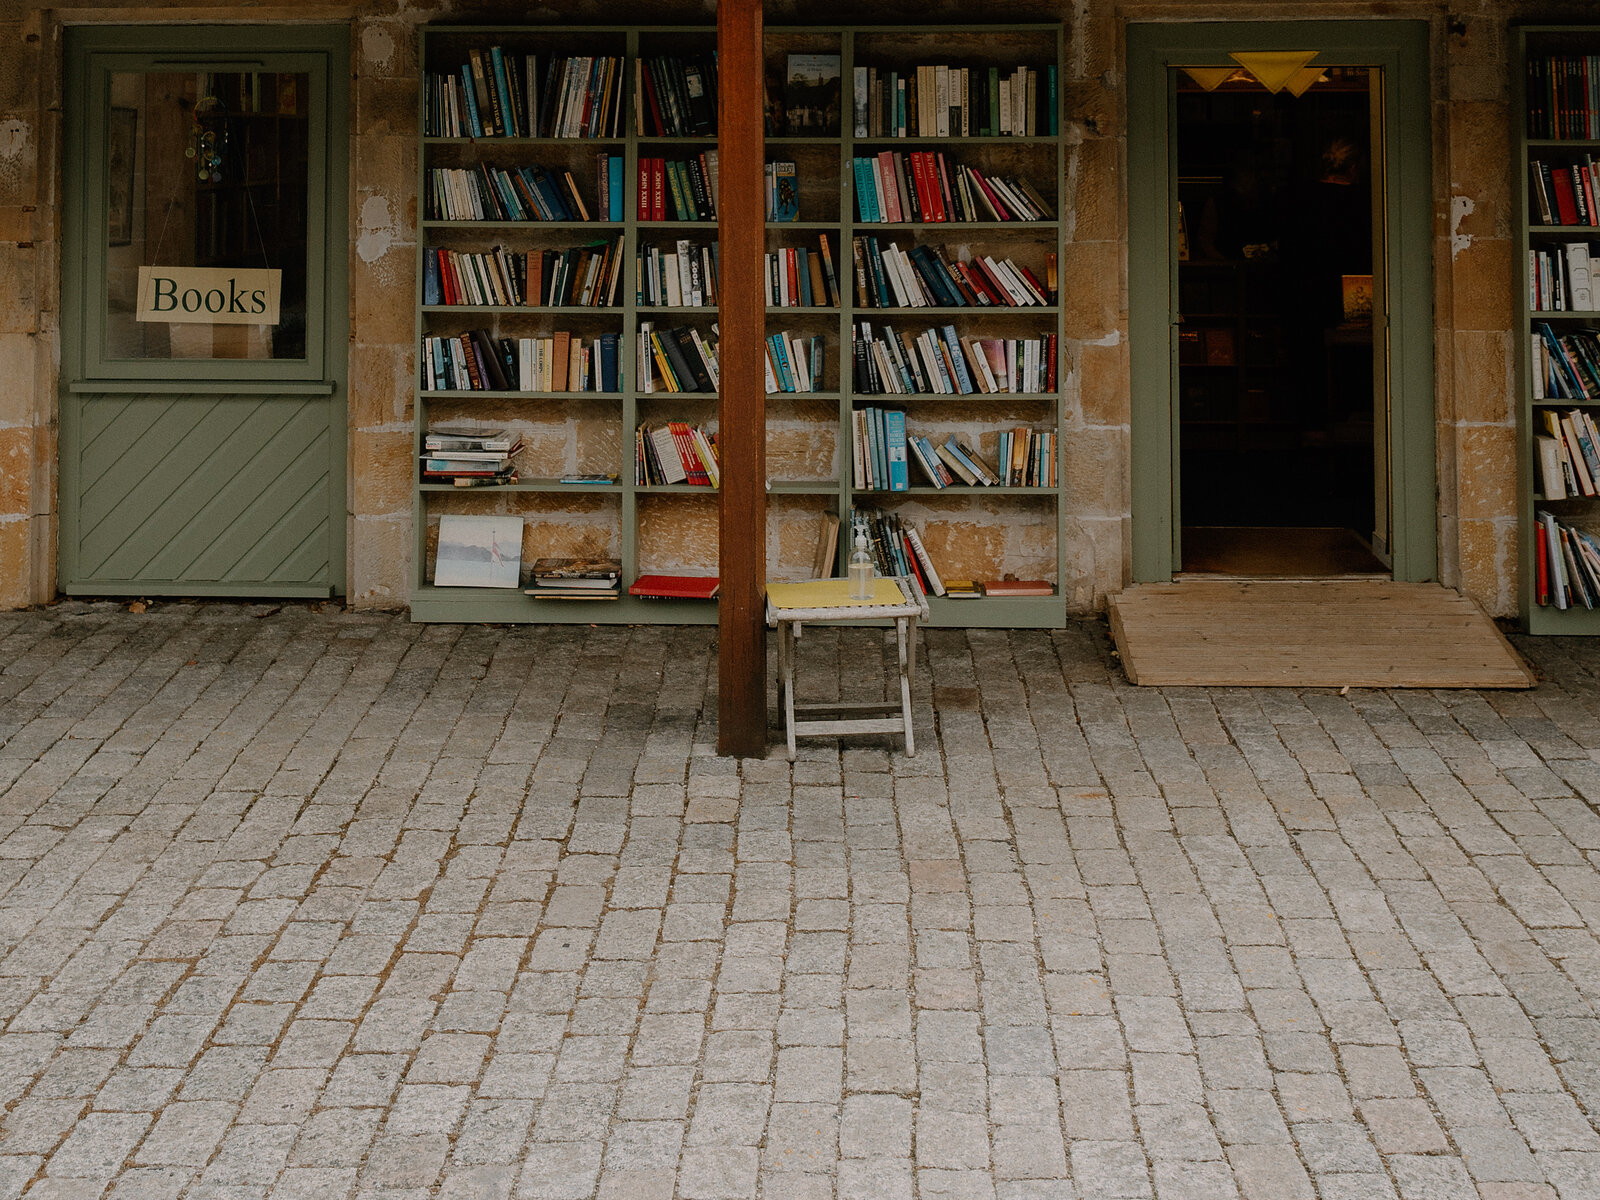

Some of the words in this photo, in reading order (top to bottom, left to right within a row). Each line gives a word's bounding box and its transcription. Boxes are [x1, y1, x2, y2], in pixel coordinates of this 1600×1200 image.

[600, 172, 608, 193] English
[1572, 164, 1581, 184] Keith
[671, 179, 679, 197] English
[675, 197, 683, 211] Bible
[1576, 184, 1586, 216] Richards
[150, 277, 266, 314] Books
